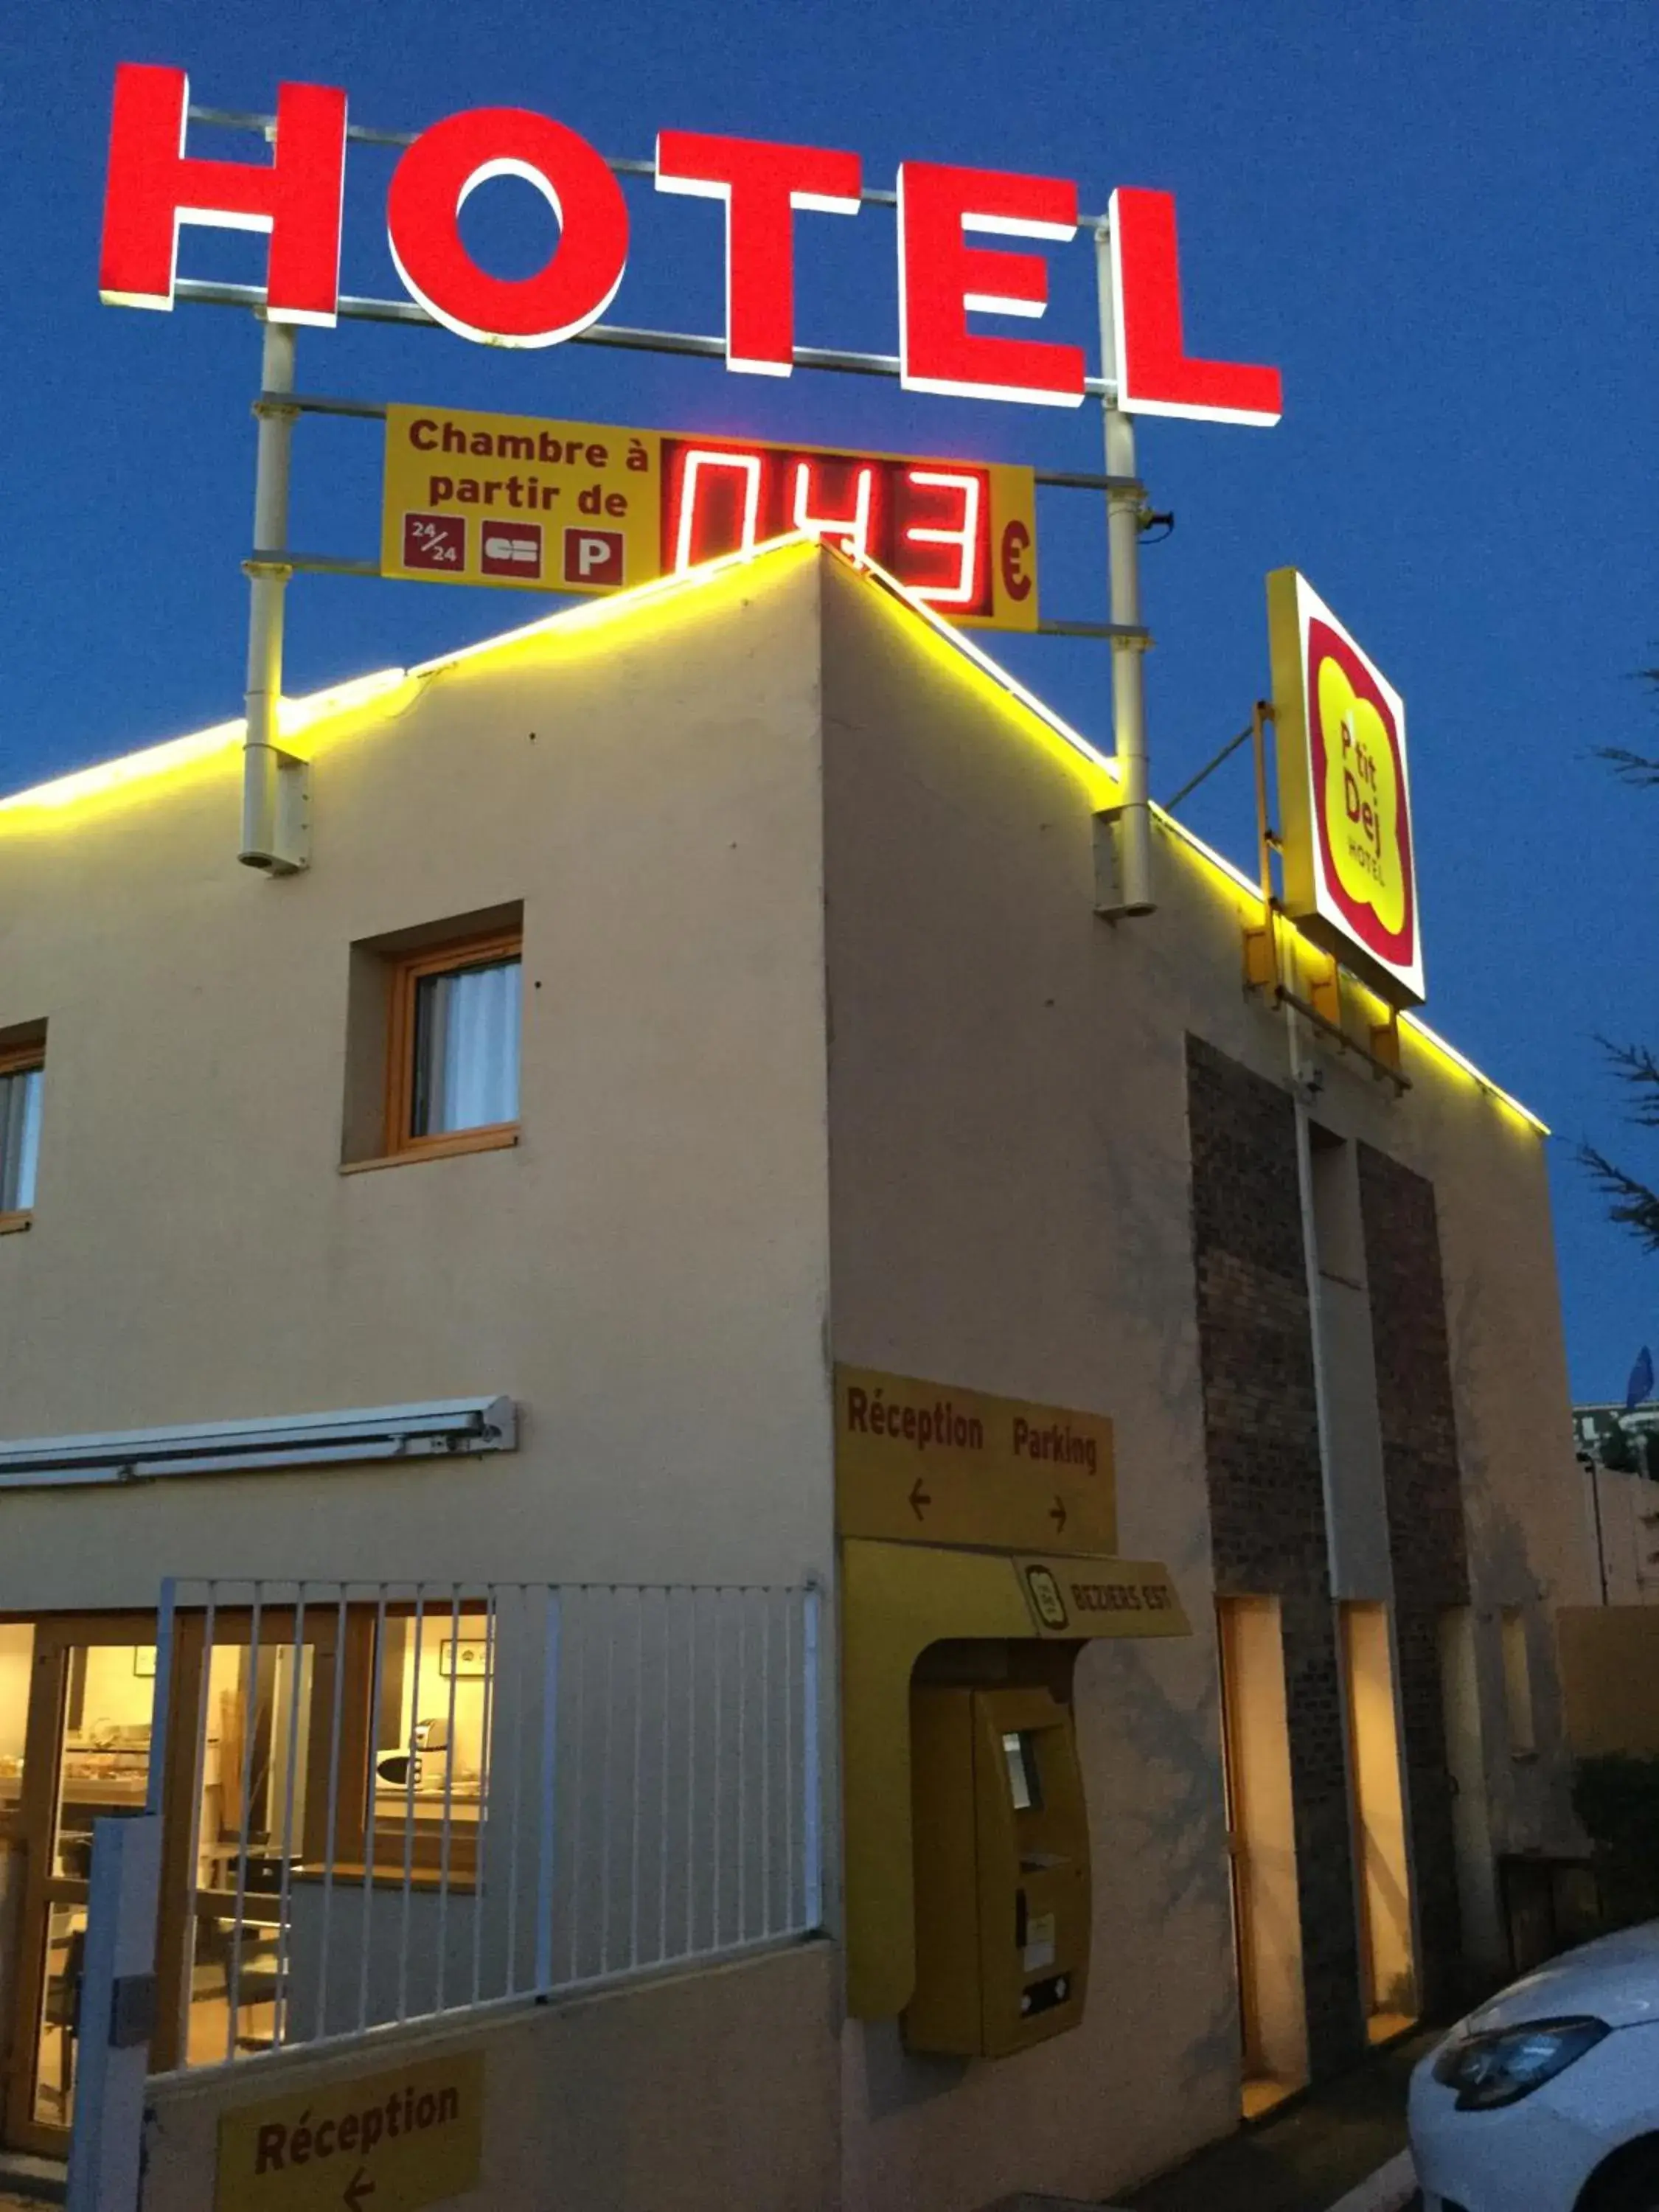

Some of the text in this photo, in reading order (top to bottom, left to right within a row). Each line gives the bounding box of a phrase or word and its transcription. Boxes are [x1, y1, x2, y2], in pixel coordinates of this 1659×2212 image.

[99, 62, 1282, 427] HOTEL
[409, 419, 649, 472] Chambre à
[429, 476, 628, 517] partir de
[579, 538, 611, 575] P
[1001, 520, 1032, 602] €
[1344, 767, 1381, 860] Dej
[1347, 835, 1386, 888] HOTEL
[847, 1387, 1097, 1475] Réception Parking
[1070, 1583, 1141, 1611] BEZIERS
[1142, 1584, 1172, 1610] EST
[254, 2086, 460, 2175] Réception
